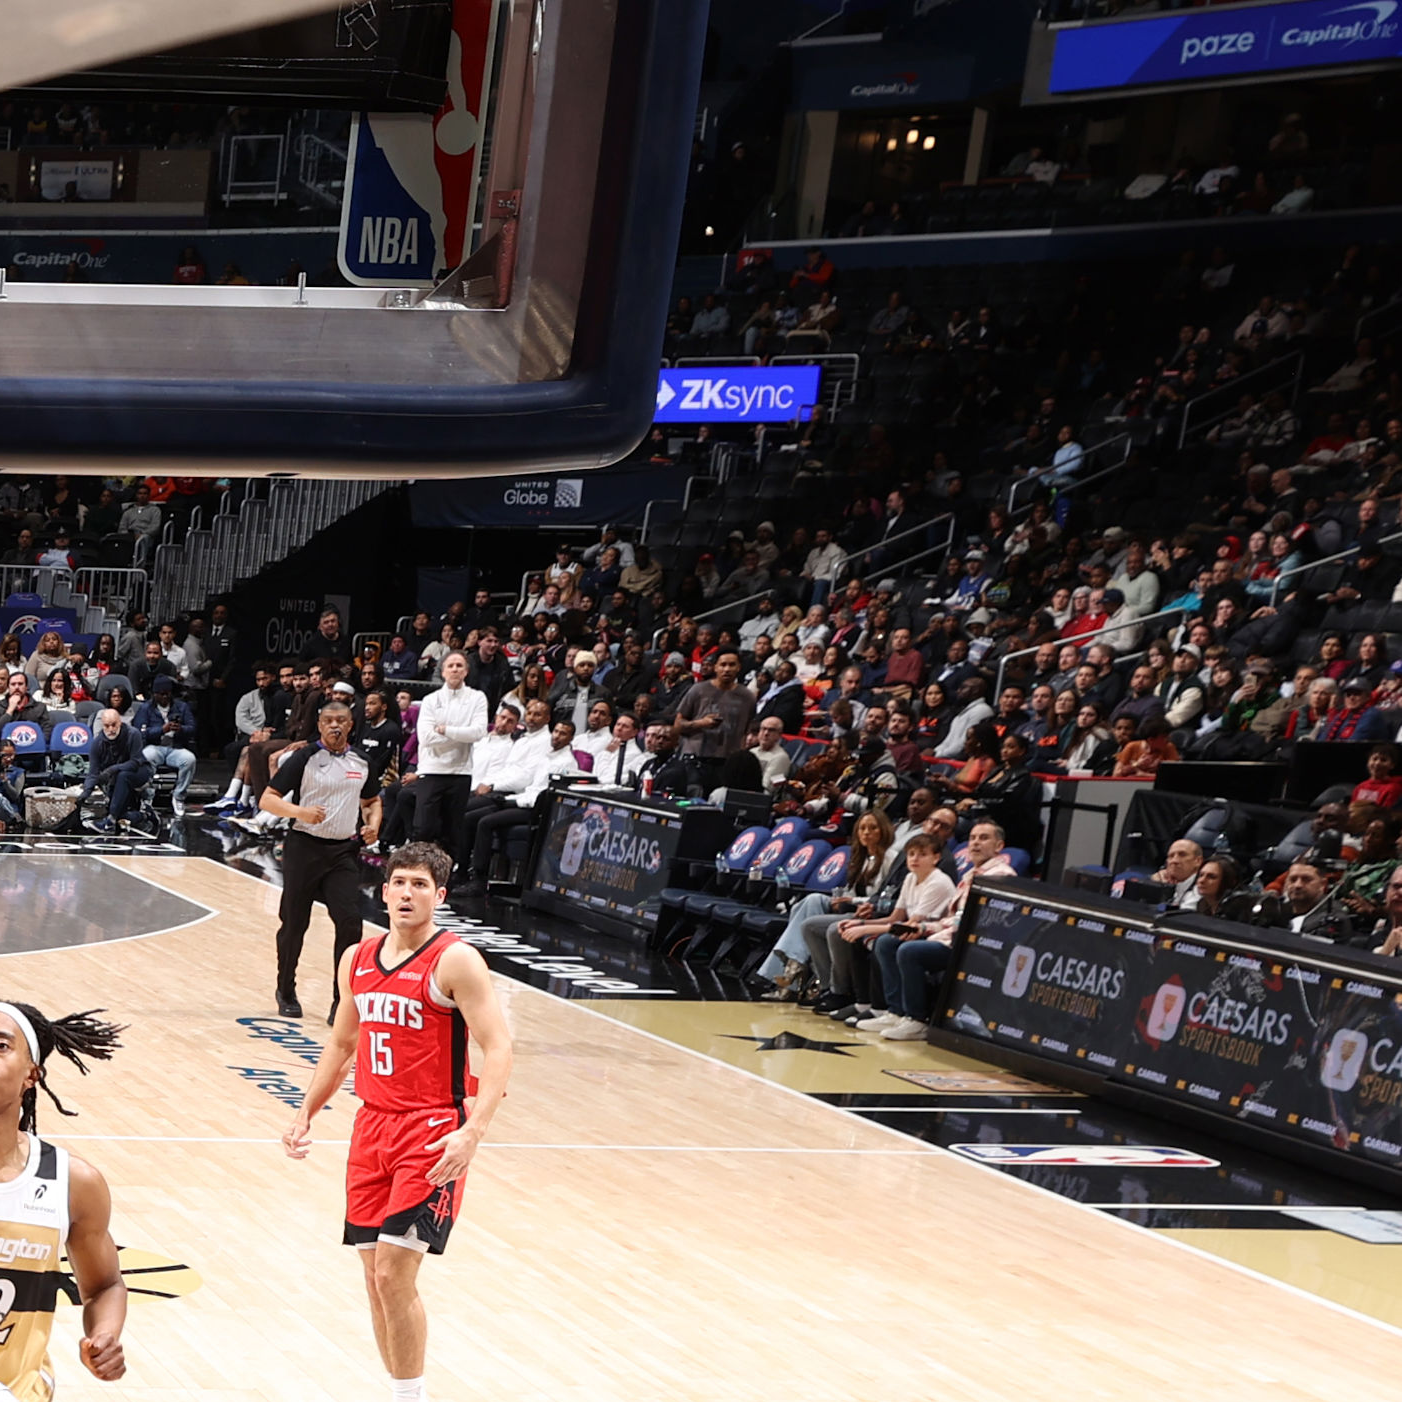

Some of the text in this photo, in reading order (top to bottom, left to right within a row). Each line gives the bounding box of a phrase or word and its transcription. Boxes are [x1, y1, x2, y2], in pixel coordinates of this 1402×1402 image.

[1180, 31, 1255, 65] paze
[358, 215, 419, 265] NBA
[679, 378, 795, 417] ZKsync
[503, 488, 549, 505] Globe
[514, 480, 551, 489] UNITED
[279, 599, 316, 613] UNITED
[587, 828, 660, 871] CAESARS
[1036, 951, 1125, 1000] CAESARS
[1028, 982, 1101, 1019] SPORTSBOOK
[1187, 991, 1293, 1045] CAESARS
[369, 1030, 394, 1076] 15
[1179, 1025, 1264, 1066] SPORTSBOOK
